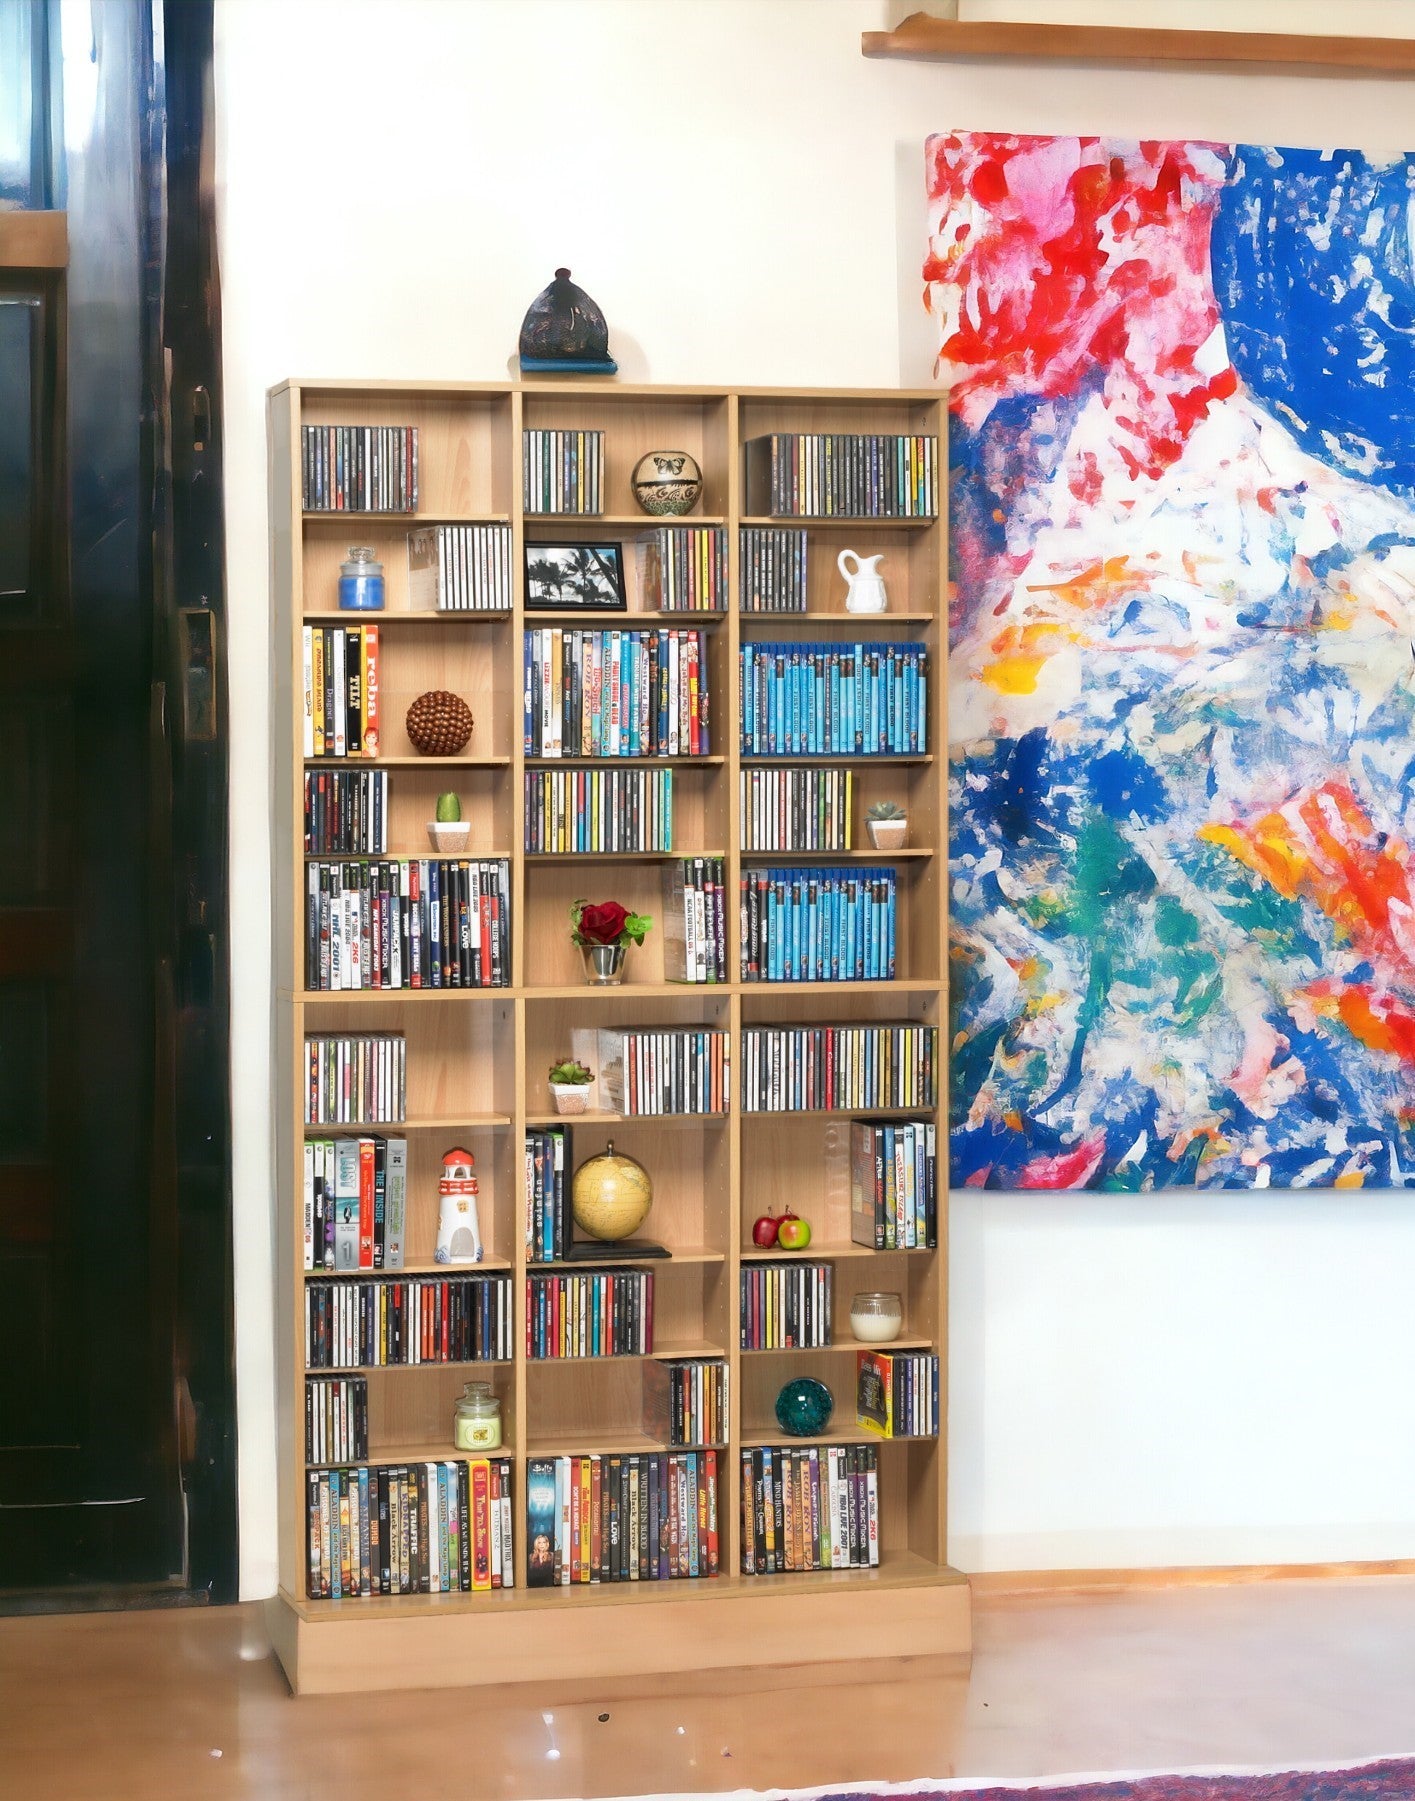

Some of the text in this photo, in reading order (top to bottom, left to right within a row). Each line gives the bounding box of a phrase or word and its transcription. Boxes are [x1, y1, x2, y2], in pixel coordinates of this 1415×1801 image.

[349, 672, 360, 706] TILT
[367, 653, 378, 715] reba
[340, 1157, 356, 1190] LOST
[895, 1153, 904, 1192] TREASURE
[375, 1170, 384, 1224] THE INSIDE
[350, 1488, 358, 1524] PRISONER
[440, 1482, 448, 1523] ALADDIN
[475, 1495, 486, 1514] That
[640, 1514, 648, 1523] IN
[321, 1526, 329, 1535] OF
[350, 1526, 358, 1535] OF
